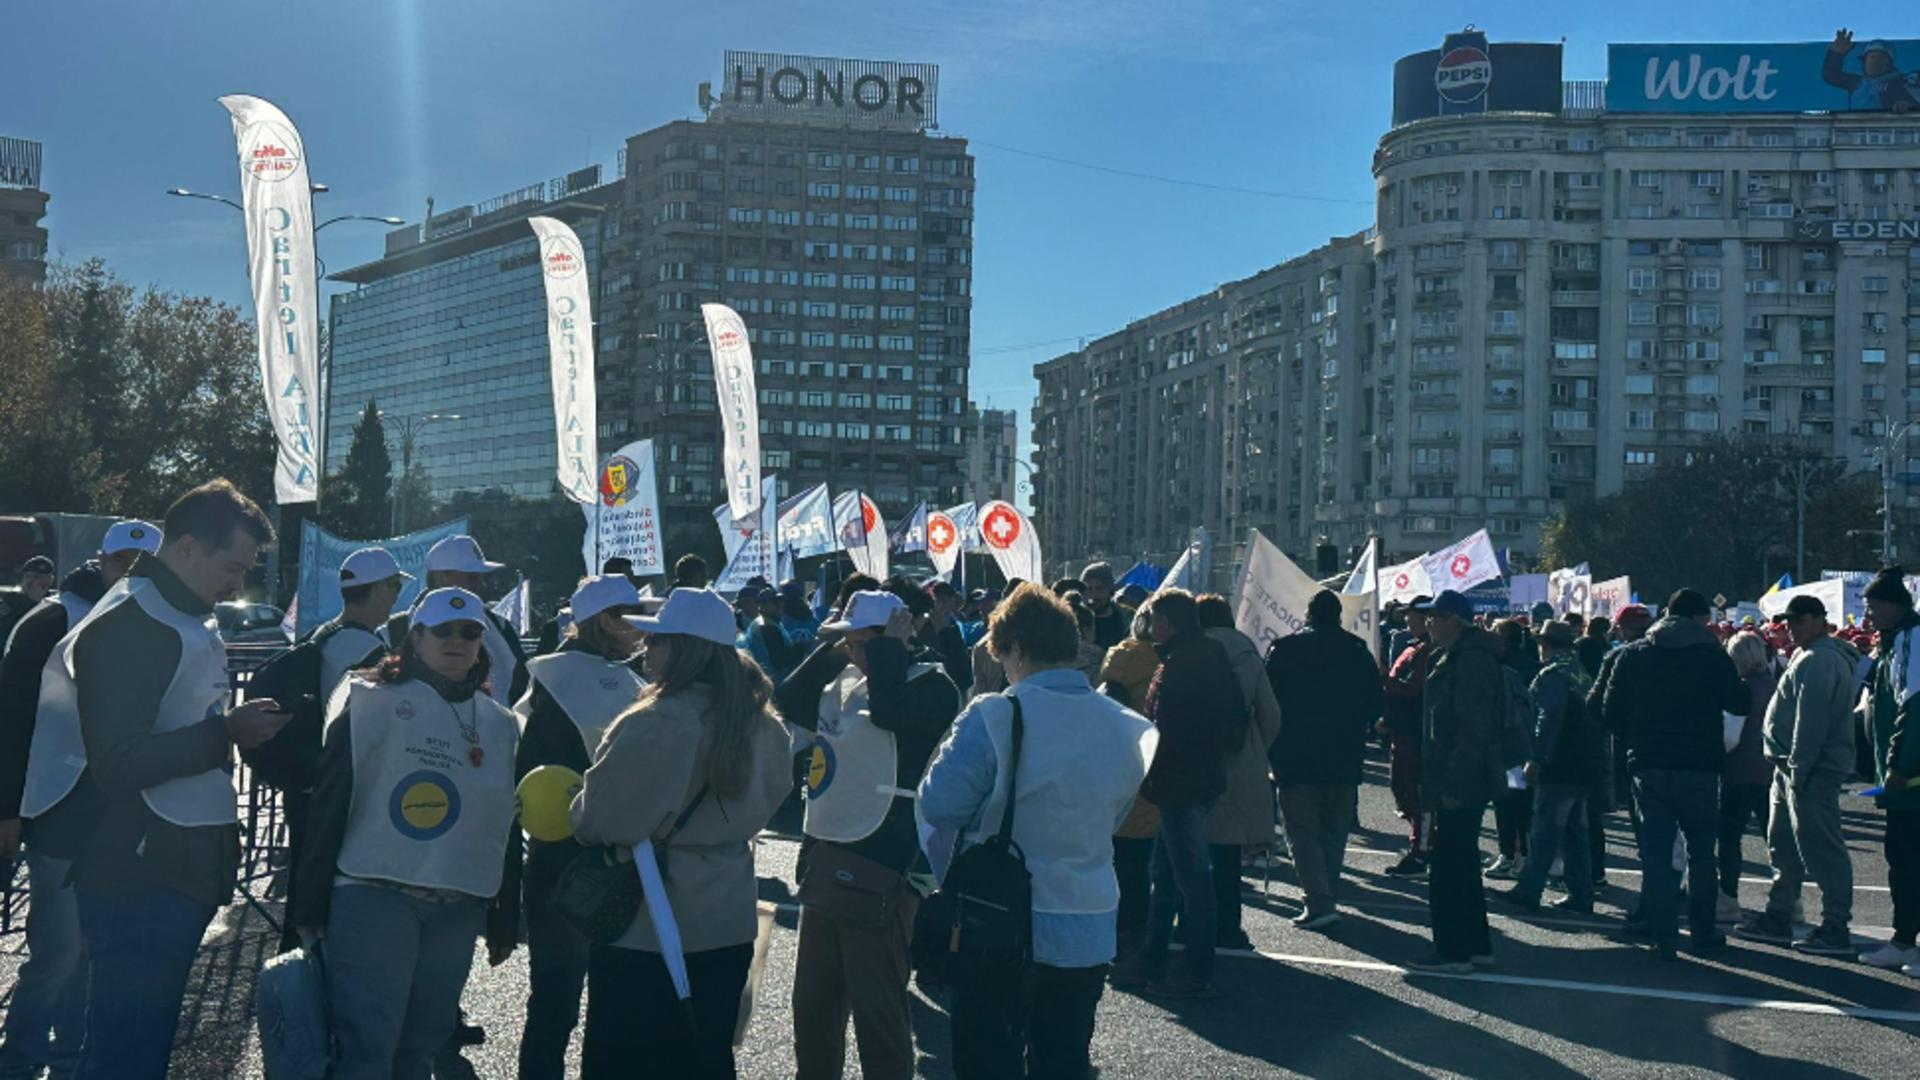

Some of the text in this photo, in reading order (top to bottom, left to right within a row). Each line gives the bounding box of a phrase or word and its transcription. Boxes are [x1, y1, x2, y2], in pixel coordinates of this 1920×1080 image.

[735, 64, 925, 114] HONOR
[1439, 66, 1489, 84] PEPSI
[1644, 53, 1779, 101] Wolt
